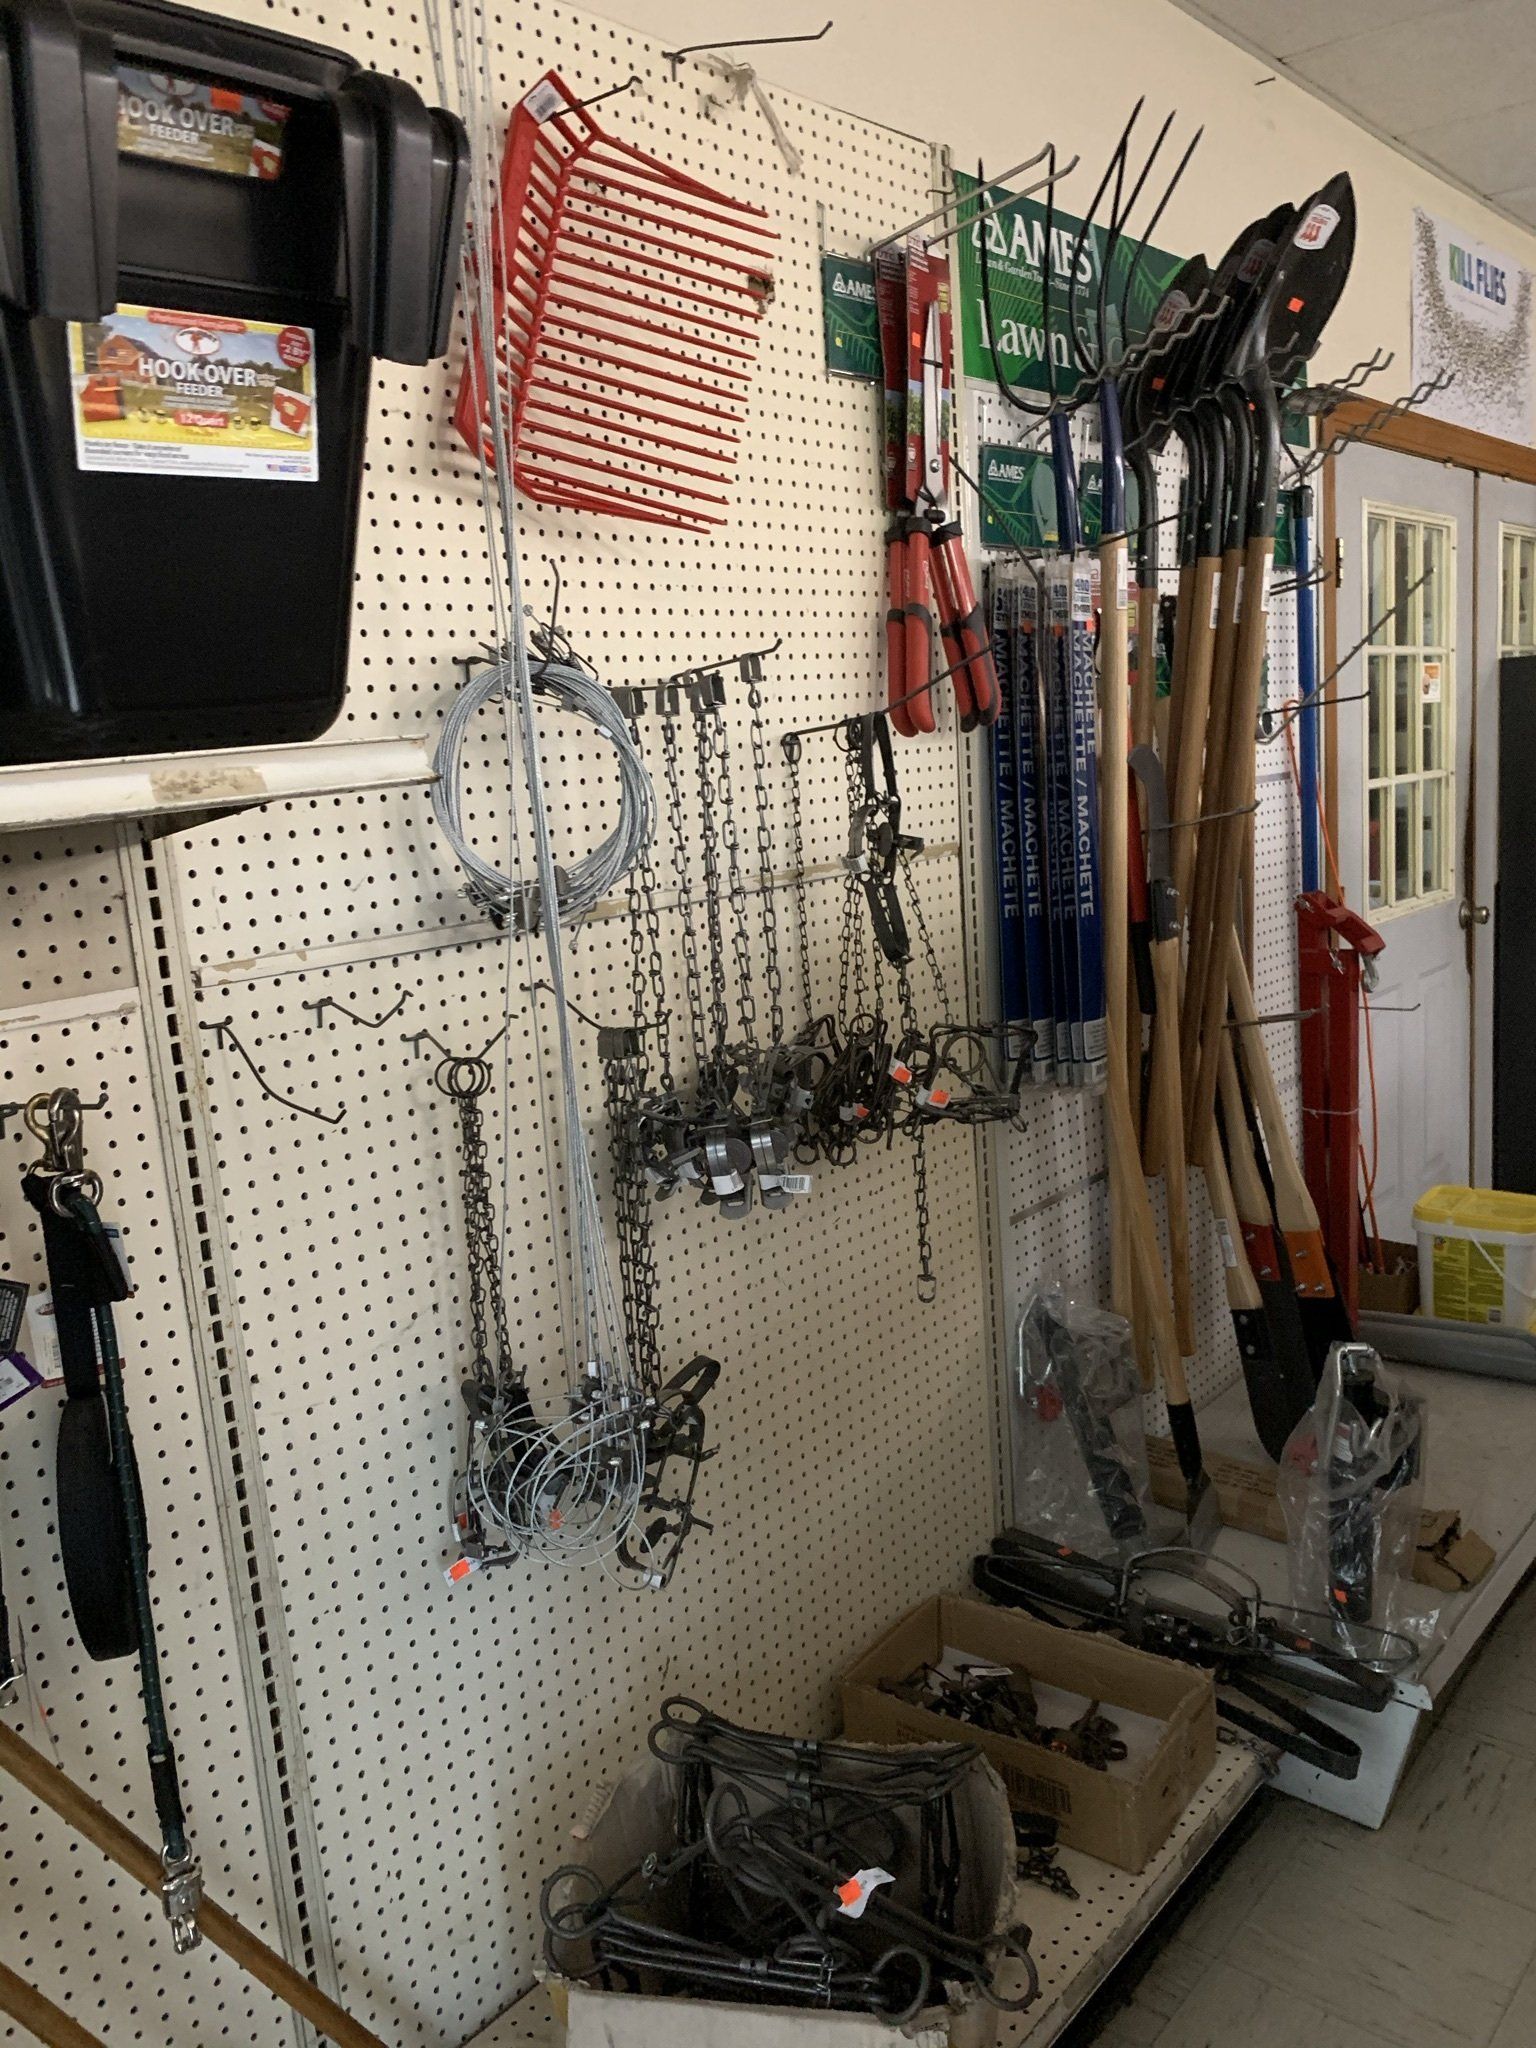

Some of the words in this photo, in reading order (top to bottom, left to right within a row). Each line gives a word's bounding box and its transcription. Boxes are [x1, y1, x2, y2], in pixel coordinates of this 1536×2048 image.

[149, 124, 199, 144] FEEDER
[179, 108, 234, 137] OVER
[975, 251, 997, 269] Lwn
[1004, 261, 1032, 280] Garden
[1008, 213, 1093, 284] AMES
[1449, 243, 1475, 291] KILL
[1477, 258, 1506, 306] FLIES
[977, 299, 1071, 369] Lawn
[138, 358, 201, 382] HOOK
[202, 365, 257, 387] OVER
[176, 383, 224, 397] FEEDER
[998, 464, 1024, 481] AMES
[1073, 630, 1087, 771] MACHETTE
[1082, 631, 1097, 754] MACHETE
[1000, 799, 1019, 918] MACHETE
[1023, 798, 1042, 917] MACHETE
[1058, 799, 1076, 920] MACHETE
[1077, 795, 1094, 918] MACHETE
